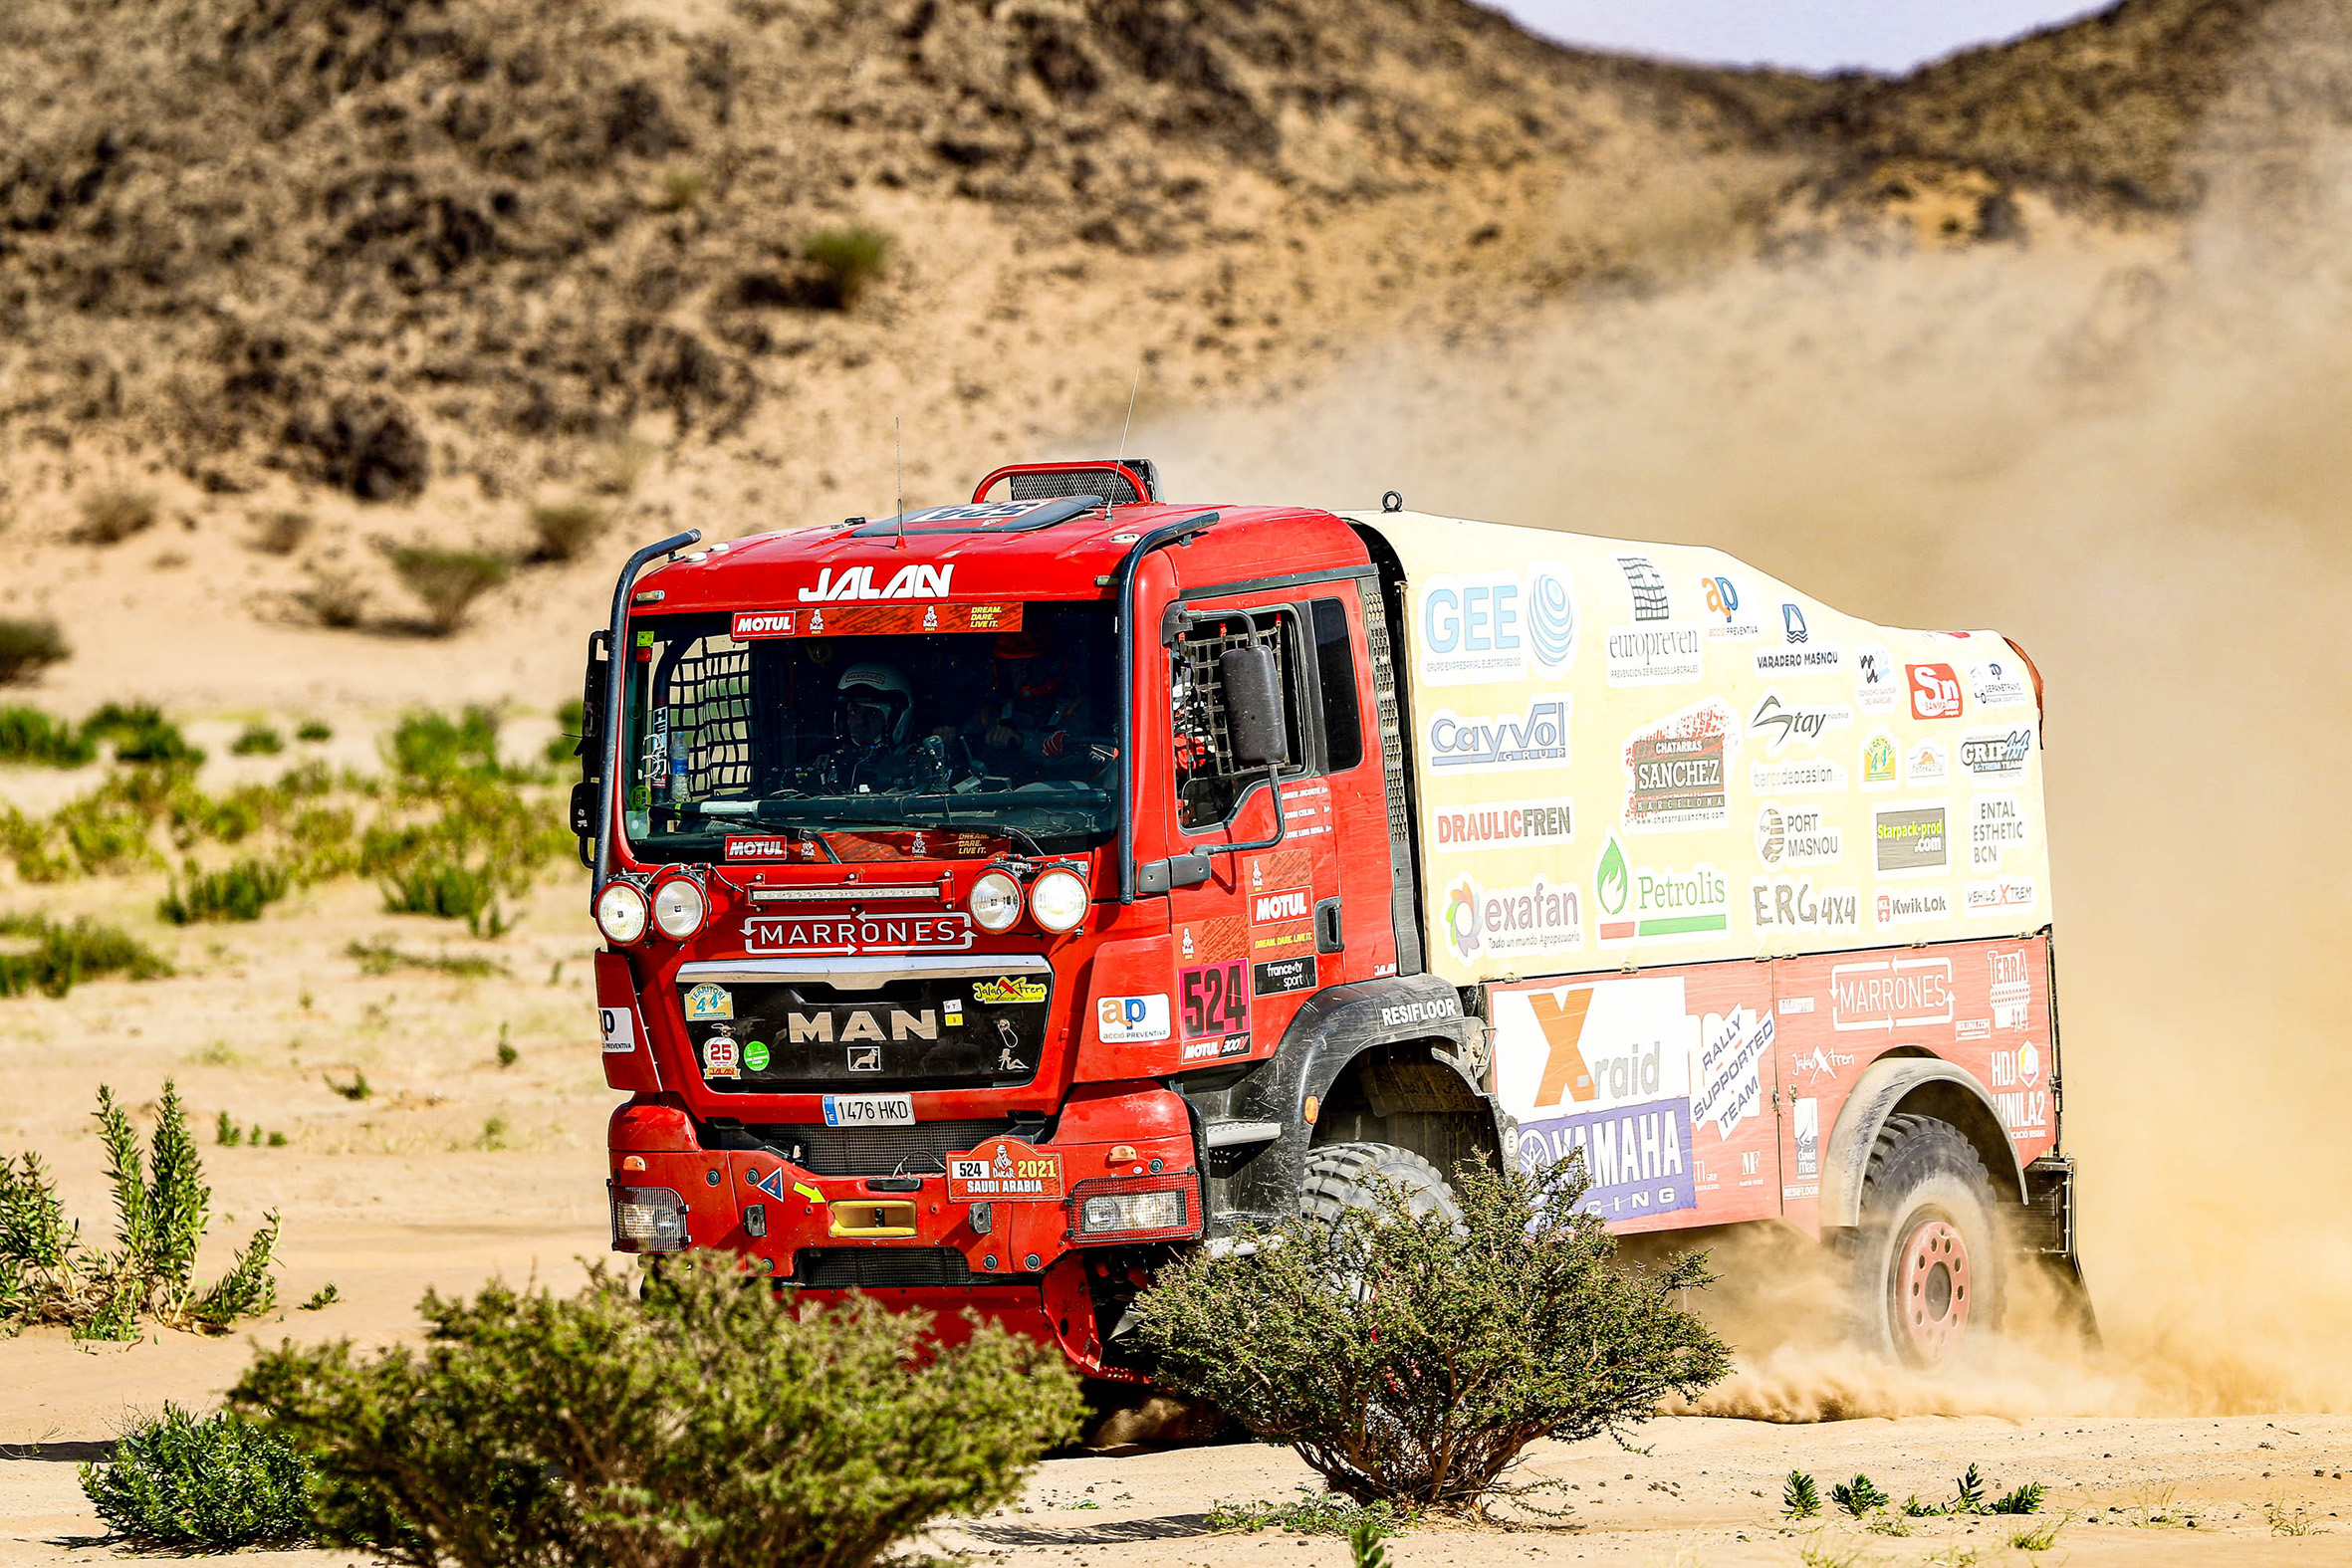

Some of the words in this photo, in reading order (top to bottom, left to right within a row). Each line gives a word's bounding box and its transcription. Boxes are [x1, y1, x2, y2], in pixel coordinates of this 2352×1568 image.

[798, 563, 955, 603] JALAN
[970, 605, 1003, 614] DREAM.
[1425, 584, 1521, 654] GEE
[736, 615, 793, 633] MOTUL
[1609, 630, 1699, 666] europreven
[1757, 654, 1802, 669] VARADERO
[1803, 652, 1839, 665] MASNOU
[1502, 749, 1565, 762] GRUP
[1655, 741, 1703, 755] CHATARRAS
[1638, 759, 1721, 790] SANCHEZ
[1637, 798, 1723, 811] BARCELONA
[1978, 799, 2015, 819] ENTAL
[1437, 805, 1571, 844] DRAULICFREN
[1787, 813, 1818, 833] PORT
[1973, 821, 2023, 841] ESTHETIC
[729, 840, 784, 856] MOTUL
[1787, 836, 1838, 857] MASNOU
[1914, 836, 1943, 853] .com
[1974, 845, 1998, 863] BCN
[1638, 871, 1726, 910] Petrolis
[1256, 892, 1307, 922] MOTUL
[1485, 882, 1579, 933] exafan
[1753, 883, 1818, 926] ERG
[1892, 897, 1923, 915] Kwik
[1924, 895, 1948, 913] Lok
[760, 920, 956, 945] MARRONES
[1489, 936, 1506, 950] Todo
[1507, 938, 1516, 948] un
[1516, 934, 1538, 947] mundo
[1538, 930, 1581, 947] Agropecuario
[1988, 949, 2029, 986] TERRA
[690, 985, 727, 1002] TERRITORI
[1283, 975, 1304, 992] sport
[1183, 965, 1247, 1037] 524
[1839, 974, 1947, 1014] MARRONES
[1381, 998, 1457, 1026] RESIFLOOR
[788, 1008, 938, 1043] MAN
[1103, 1030, 1125, 1039] acció
[1126, 1029, 1167, 1039] PREVENTIVA
[710, 1043, 732, 1061] 25
[1184, 1040, 1220, 1059] MOTUL
[1222, 1035, 1250, 1054] 300V
[1702, 1012, 1743, 1072] RALLY
[1693, 1019, 1773, 1122] SUPPORTED
[1992, 1049, 2016, 1087] HDJ
[838, 1101, 875, 1120] 1476
[880, 1101, 908, 1119] HKD
[1720, 1075, 1760, 1129] TEAM
[959, 1162, 983, 1178] 524
[1018, 1160, 1057, 1178] 2021
[1741, 1150, 1761, 1176] MF
[1797, 1162, 1816, 1174] mas
[966, 1179, 1000, 1194] SAUDI
[1002, 1178, 1044, 1193] ARABIA
